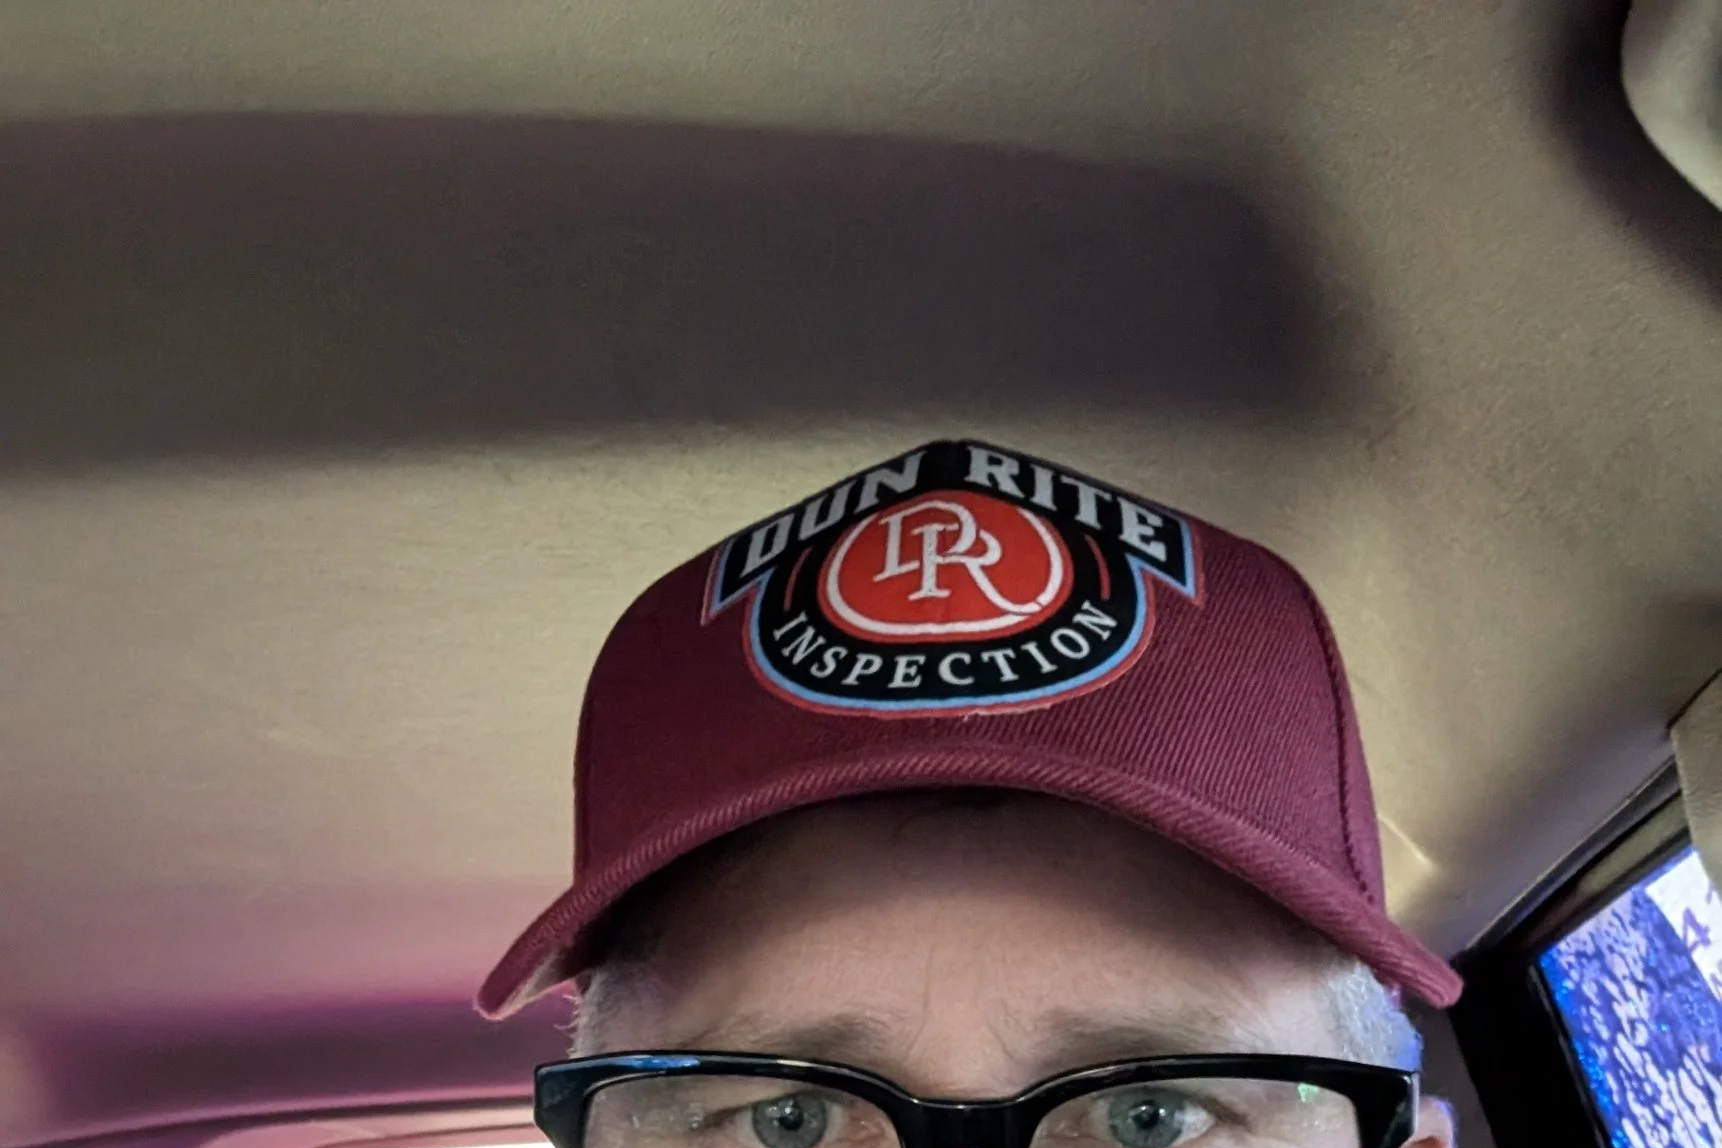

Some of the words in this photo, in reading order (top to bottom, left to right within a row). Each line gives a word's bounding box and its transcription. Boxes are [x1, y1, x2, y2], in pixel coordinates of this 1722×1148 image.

[740, 450, 927, 578] DUN
[965, 444, 1168, 562] RITE
[772, 600, 1119, 688] INSPECTION
